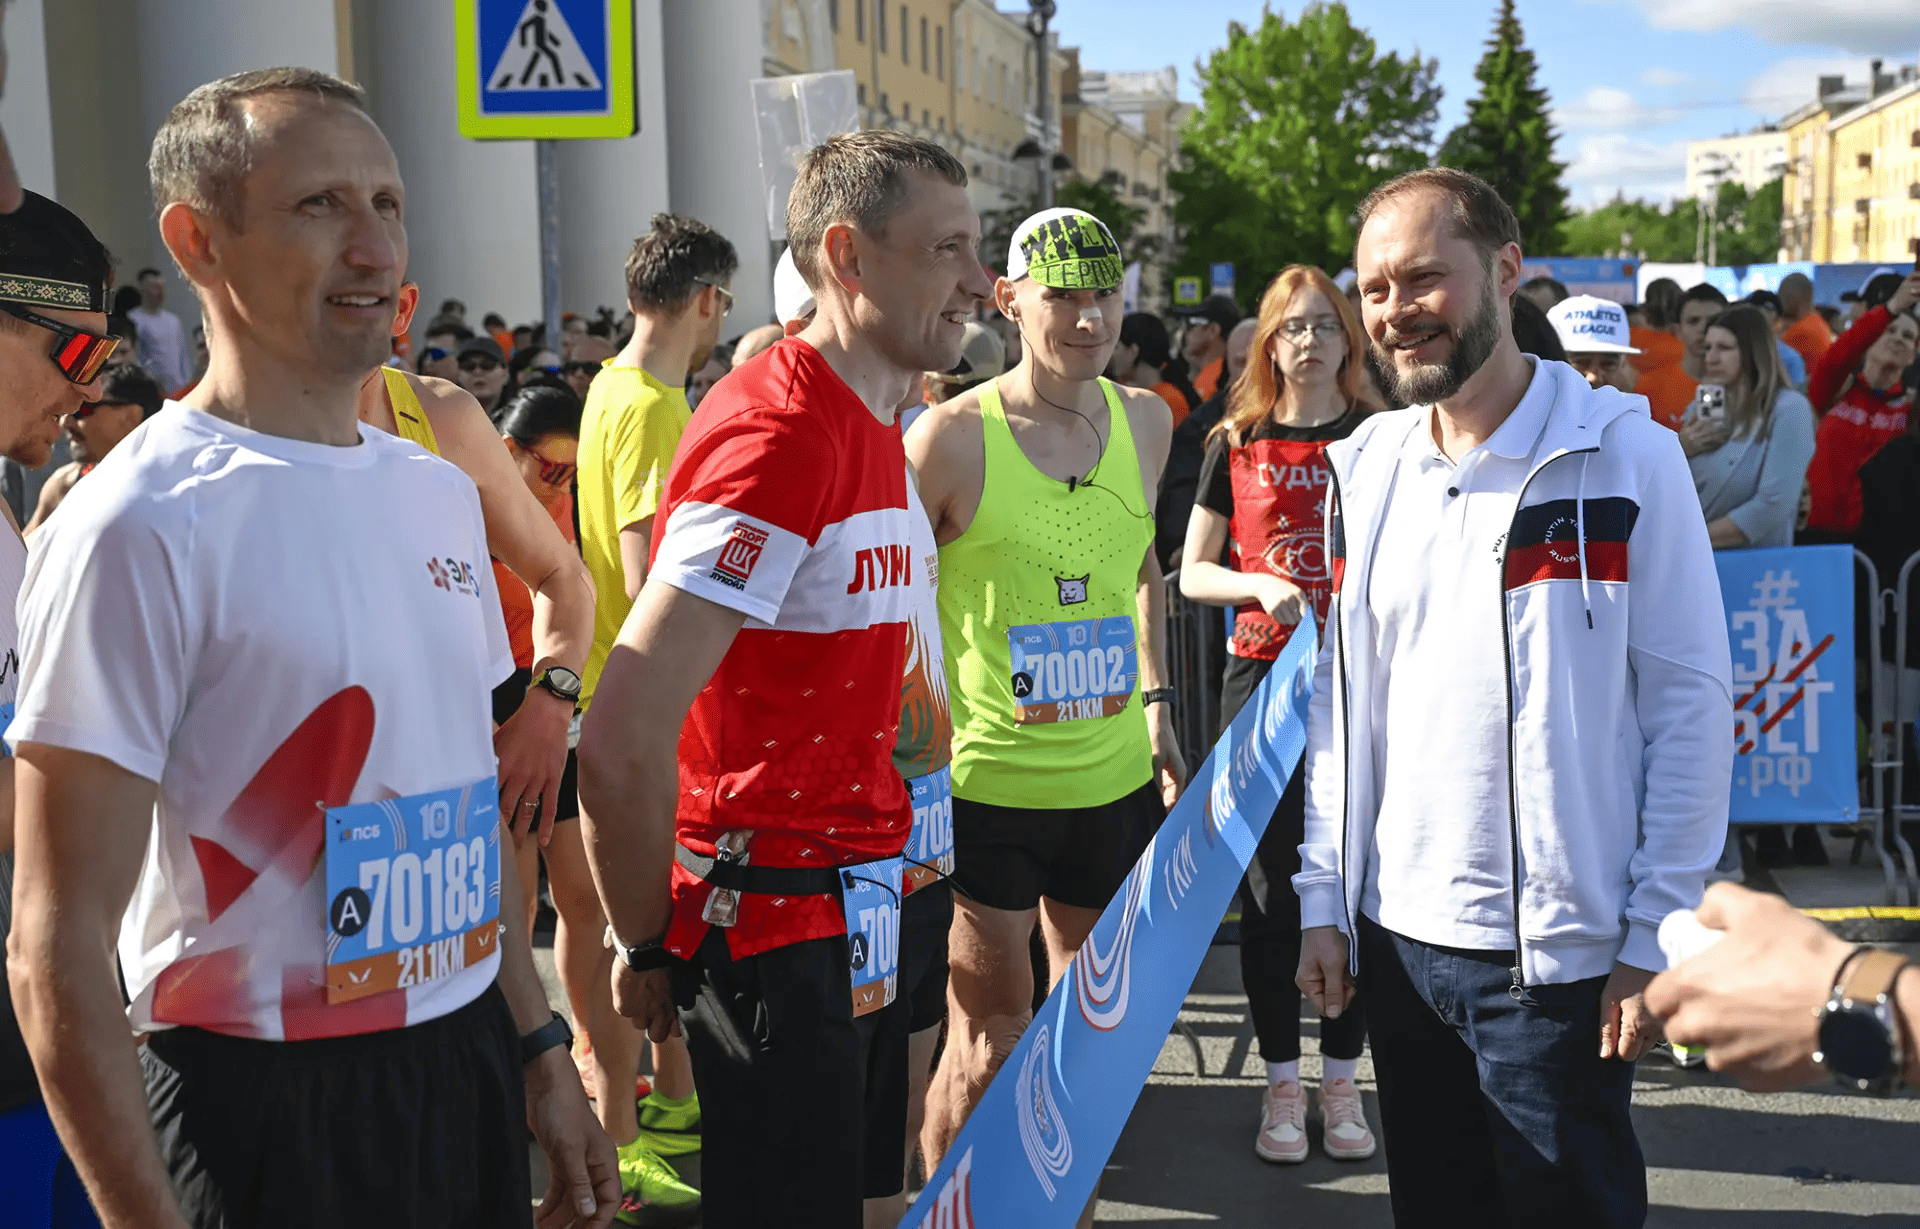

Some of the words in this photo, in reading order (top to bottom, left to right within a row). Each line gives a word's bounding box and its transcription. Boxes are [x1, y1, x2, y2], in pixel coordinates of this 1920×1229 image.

[1564, 309, 1621, 322] ATHLETICS
[1572, 324, 1616, 336] LEAGUE
[732, 526, 768, 546] СПОРТ
[1545, 516, 1565, 544] PUTIN
[1549, 549, 1580, 562] RUSSI
[709, 571, 745, 591] ЛУКОЙЛ
[1025, 635, 1041, 644] ПСБ
[1731, 609, 1818, 682] ЗА
[1025, 645, 1126, 701] 70002
[1015, 676, 1029, 695] A
[1057, 697, 1103, 722] 21.1KM
[913, 785, 927, 797] ПСБ
[420, 800, 450, 841] 10
[352, 824, 381, 841] ПСБ
[1172, 824, 1198, 898] KM
[359, 836, 486, 950] 70183
[855, 881, 872, 893] ПСБ
[338, 896, 362, 930] A
[397, 932, 465, 989] 21.1KM
[851, 939, 864, 964] A
